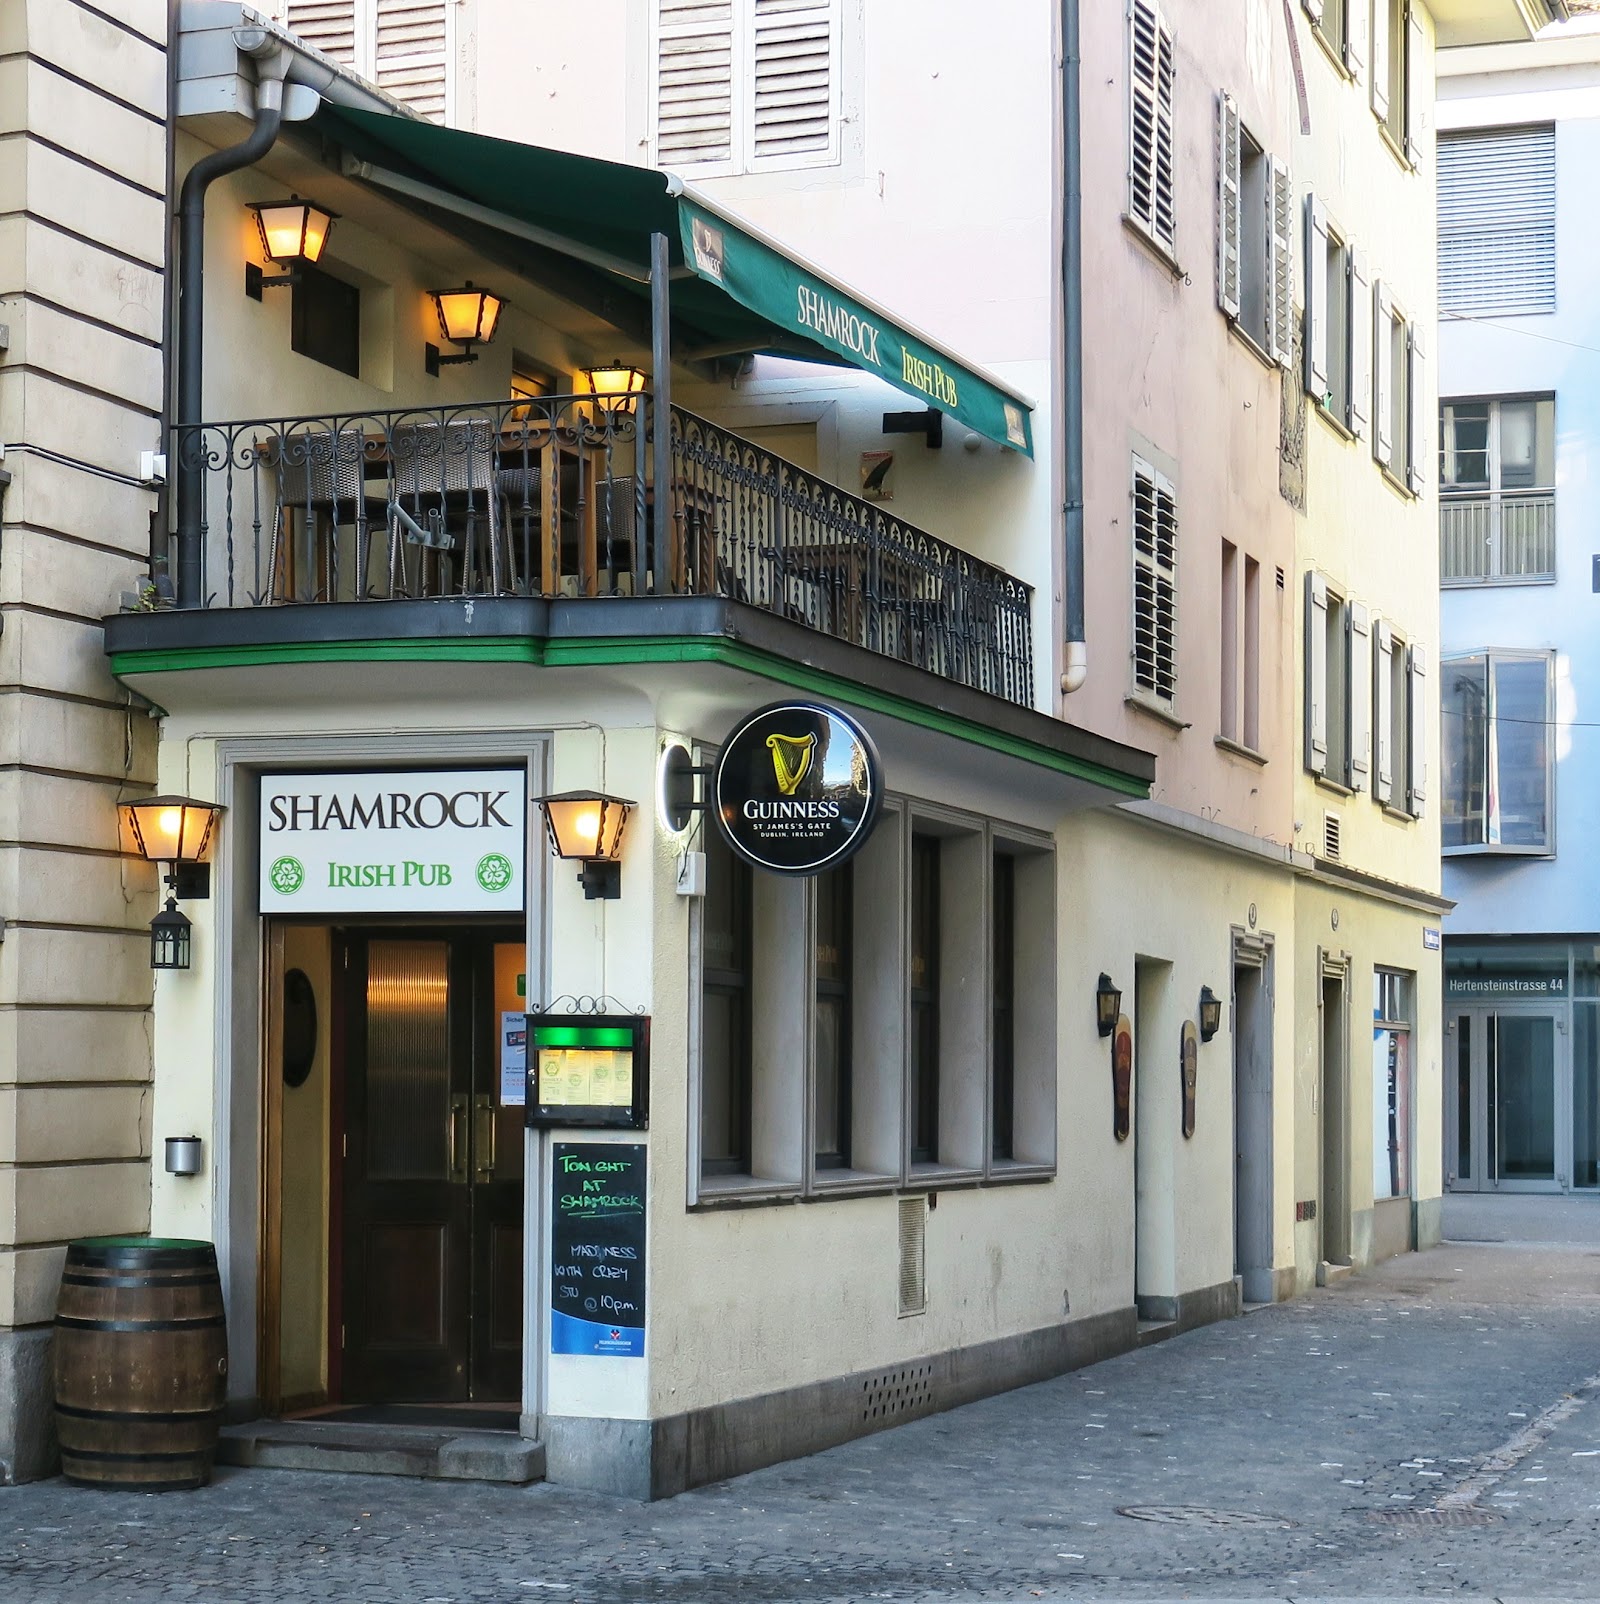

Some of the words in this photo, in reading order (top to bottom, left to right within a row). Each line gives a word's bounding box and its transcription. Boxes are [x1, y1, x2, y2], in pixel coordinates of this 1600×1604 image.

[797, 284, 881, 367] SHAMROCK
[901, 345, 932, 398] IRISH
[934, 363, 958, 408] PUB
[268, 790, 513, 832] SHAMROCK
[743, 799, 839, 819] GUINNESS
[327, 861, 396, 888] IRISH
[402, 861, 452, 887] PUB
[1450, 979, 1547, 991] Hertensteinstrasse
[1550, 979, 1563, 990] 44
[583, 1180, 606, 1191] AT
[560, 1195, 644, 1209] SHAMROCK
[554, 1264, 582, 1277] WITH
[592, 1265, 628, 1281] CRAZY
[560, 1285, 579, 1298] STU
